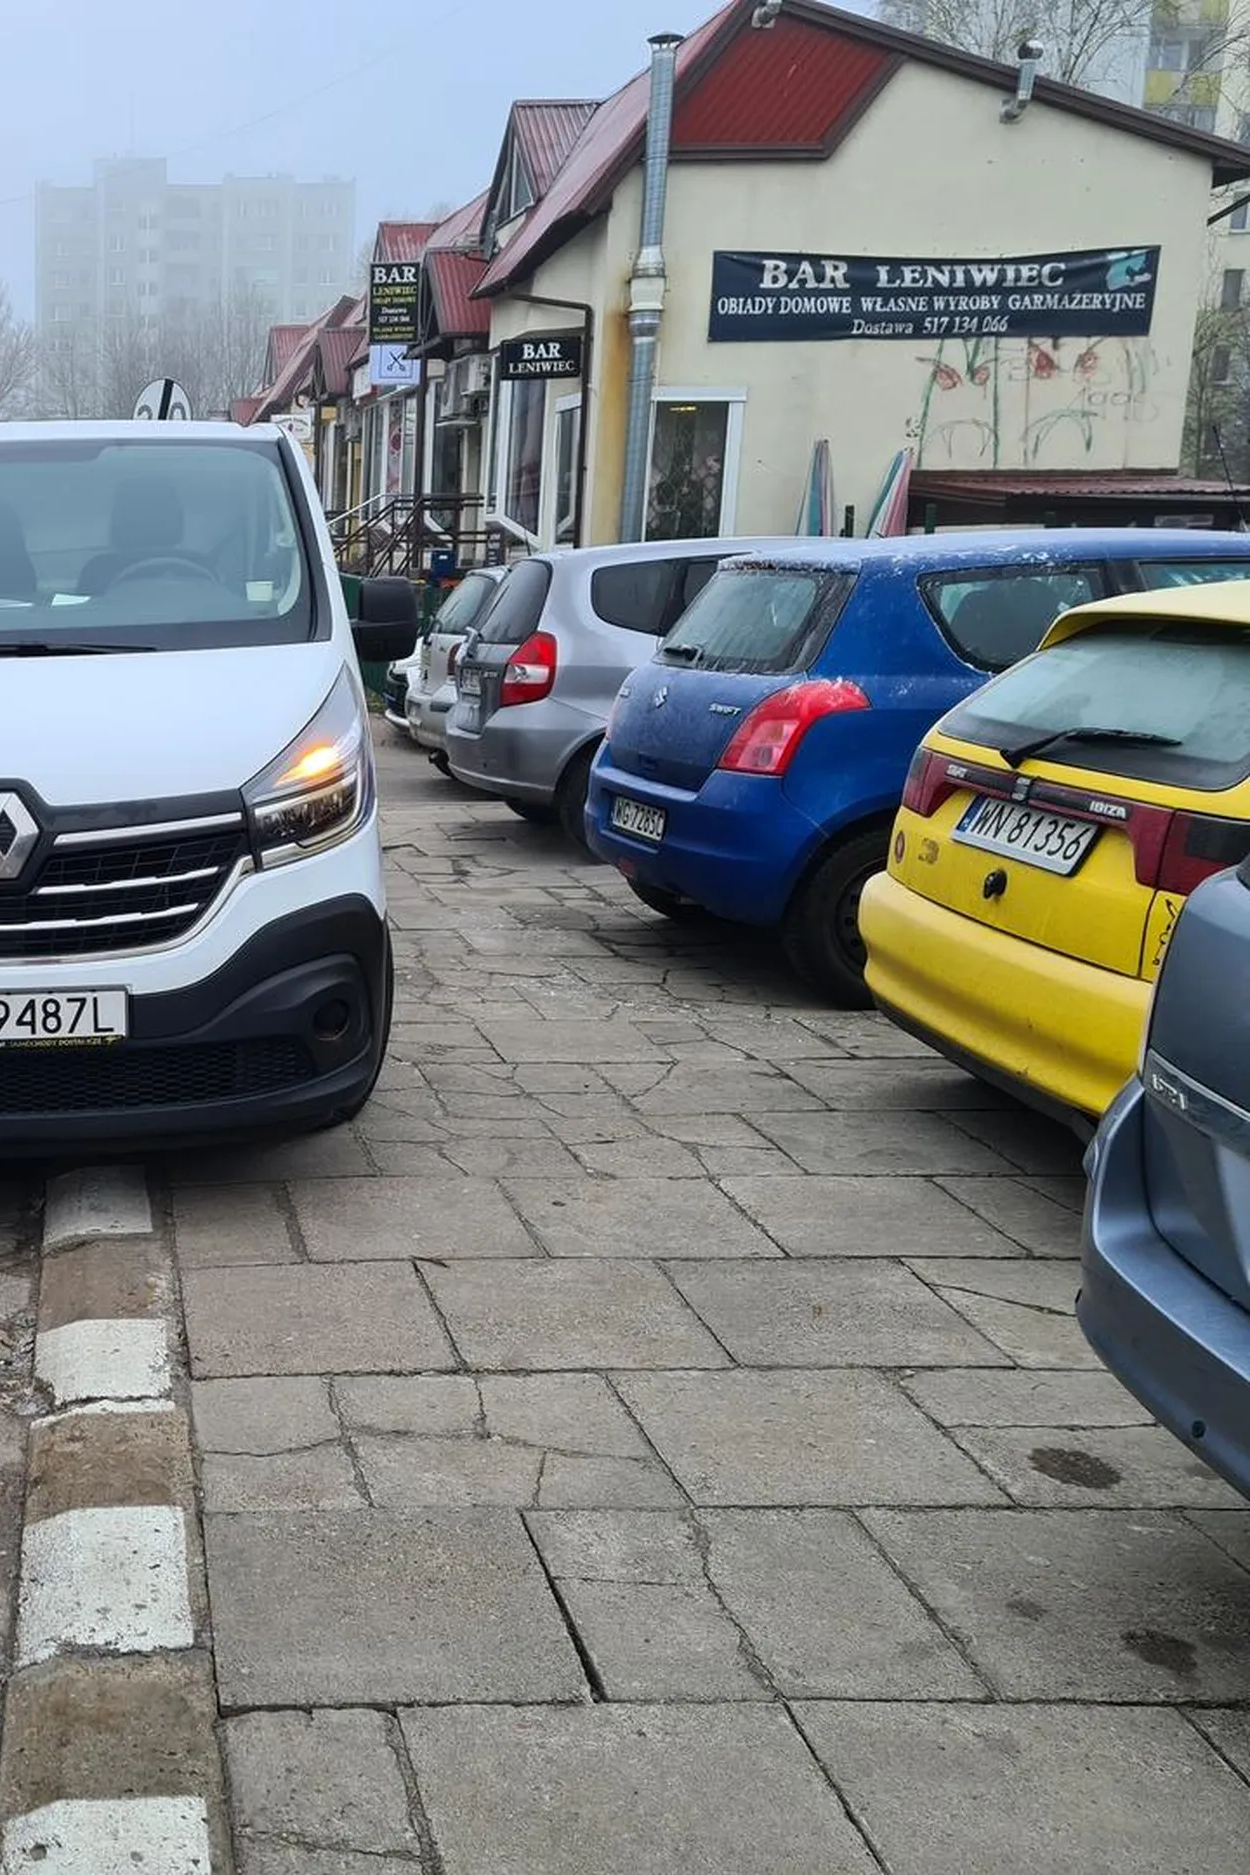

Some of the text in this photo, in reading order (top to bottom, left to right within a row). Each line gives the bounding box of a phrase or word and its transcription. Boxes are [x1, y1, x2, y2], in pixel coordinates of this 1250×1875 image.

[373, 266, 417, 284] BAR
[759, 259, 1066, 289] BAR LENIWIEC
[717, 291, 1146, 315] OBIADY DOMOWE WŁASNE WYROBY GARMAŻERYJNE
[851, 315, 1009, 335] Dostawa 517 134 066
[522, 342, 561, 359] BAR
[509, 360, 575, 373] LENIWIEC
[709, 703, 742, 715] SWIFT
[1089, 800, 1127, 818] IBIZA
[970, 802, 1090, 861] WN 81356
